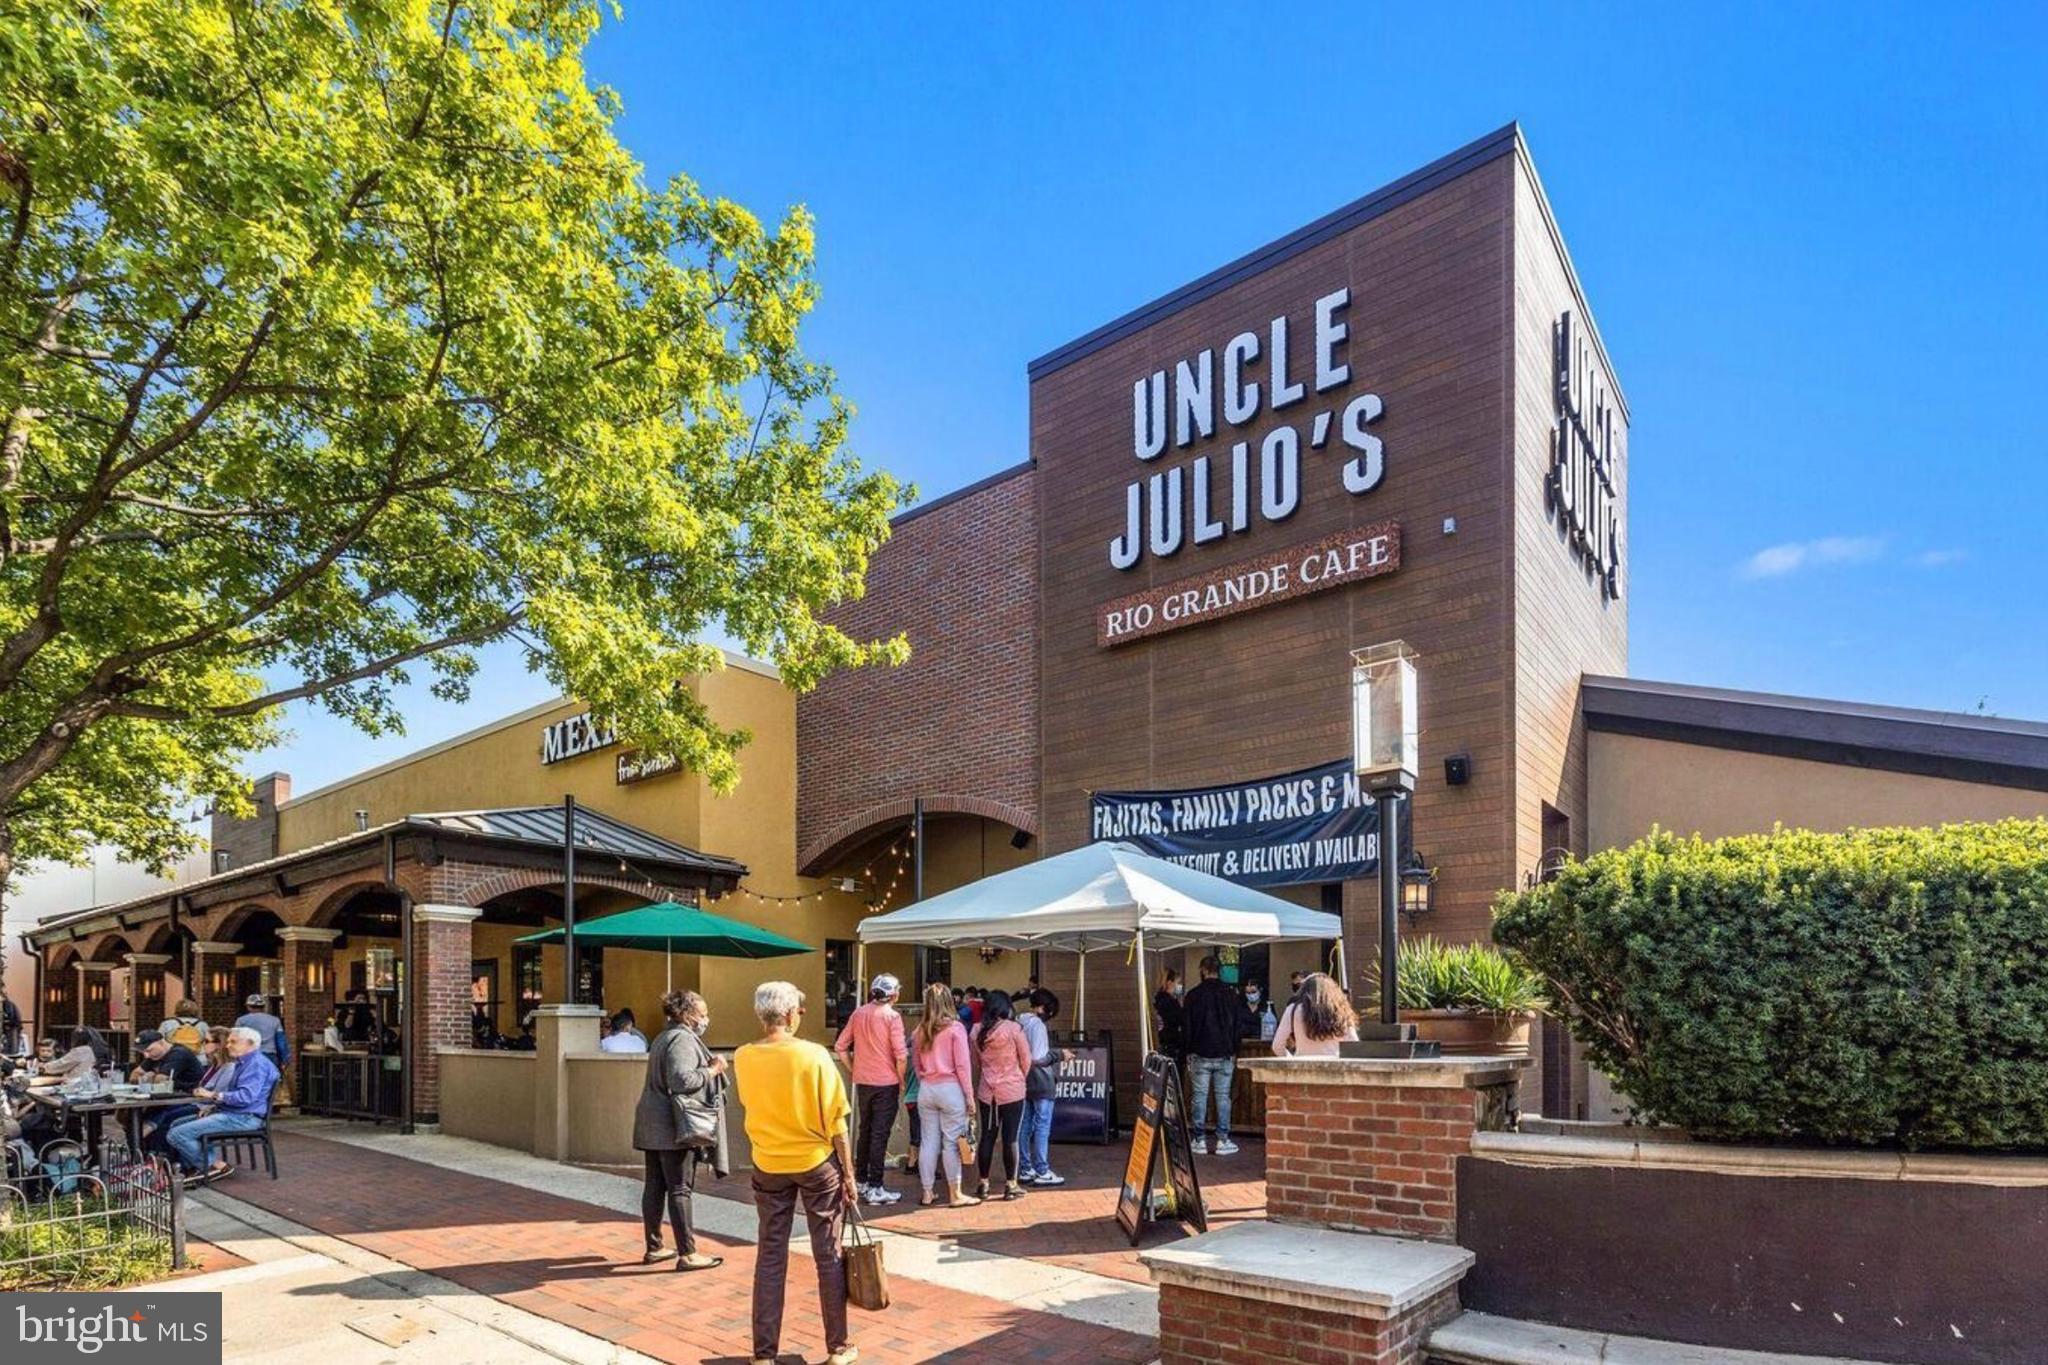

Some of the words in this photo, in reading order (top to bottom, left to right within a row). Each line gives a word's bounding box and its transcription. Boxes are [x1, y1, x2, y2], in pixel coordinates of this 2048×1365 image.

[1134, 287, 1350, 462] UNCLE
[1109, 393, 1385, 570] JULIO'S
[1105, 603, 1153, 637] RIO
[1162, 563, 1289, 622] GRANDE
[1300, 535, 1390, 584] CAFE
[1093, 801, 1169, 839] FAJITAS,
[1172, 792, 1241, 832] FAMILY
[1244, 778, 1315, 823] PACKS
[1222, 850, 1240, 876] &
[1243, 841, 1311, 875] DELIVERY
[1314, 832, 1380, 866] AVAILAB
[1054, 1081, 1106, 1099] HECK-IN
[1060, 1059, 1096, 1078] PATIO
